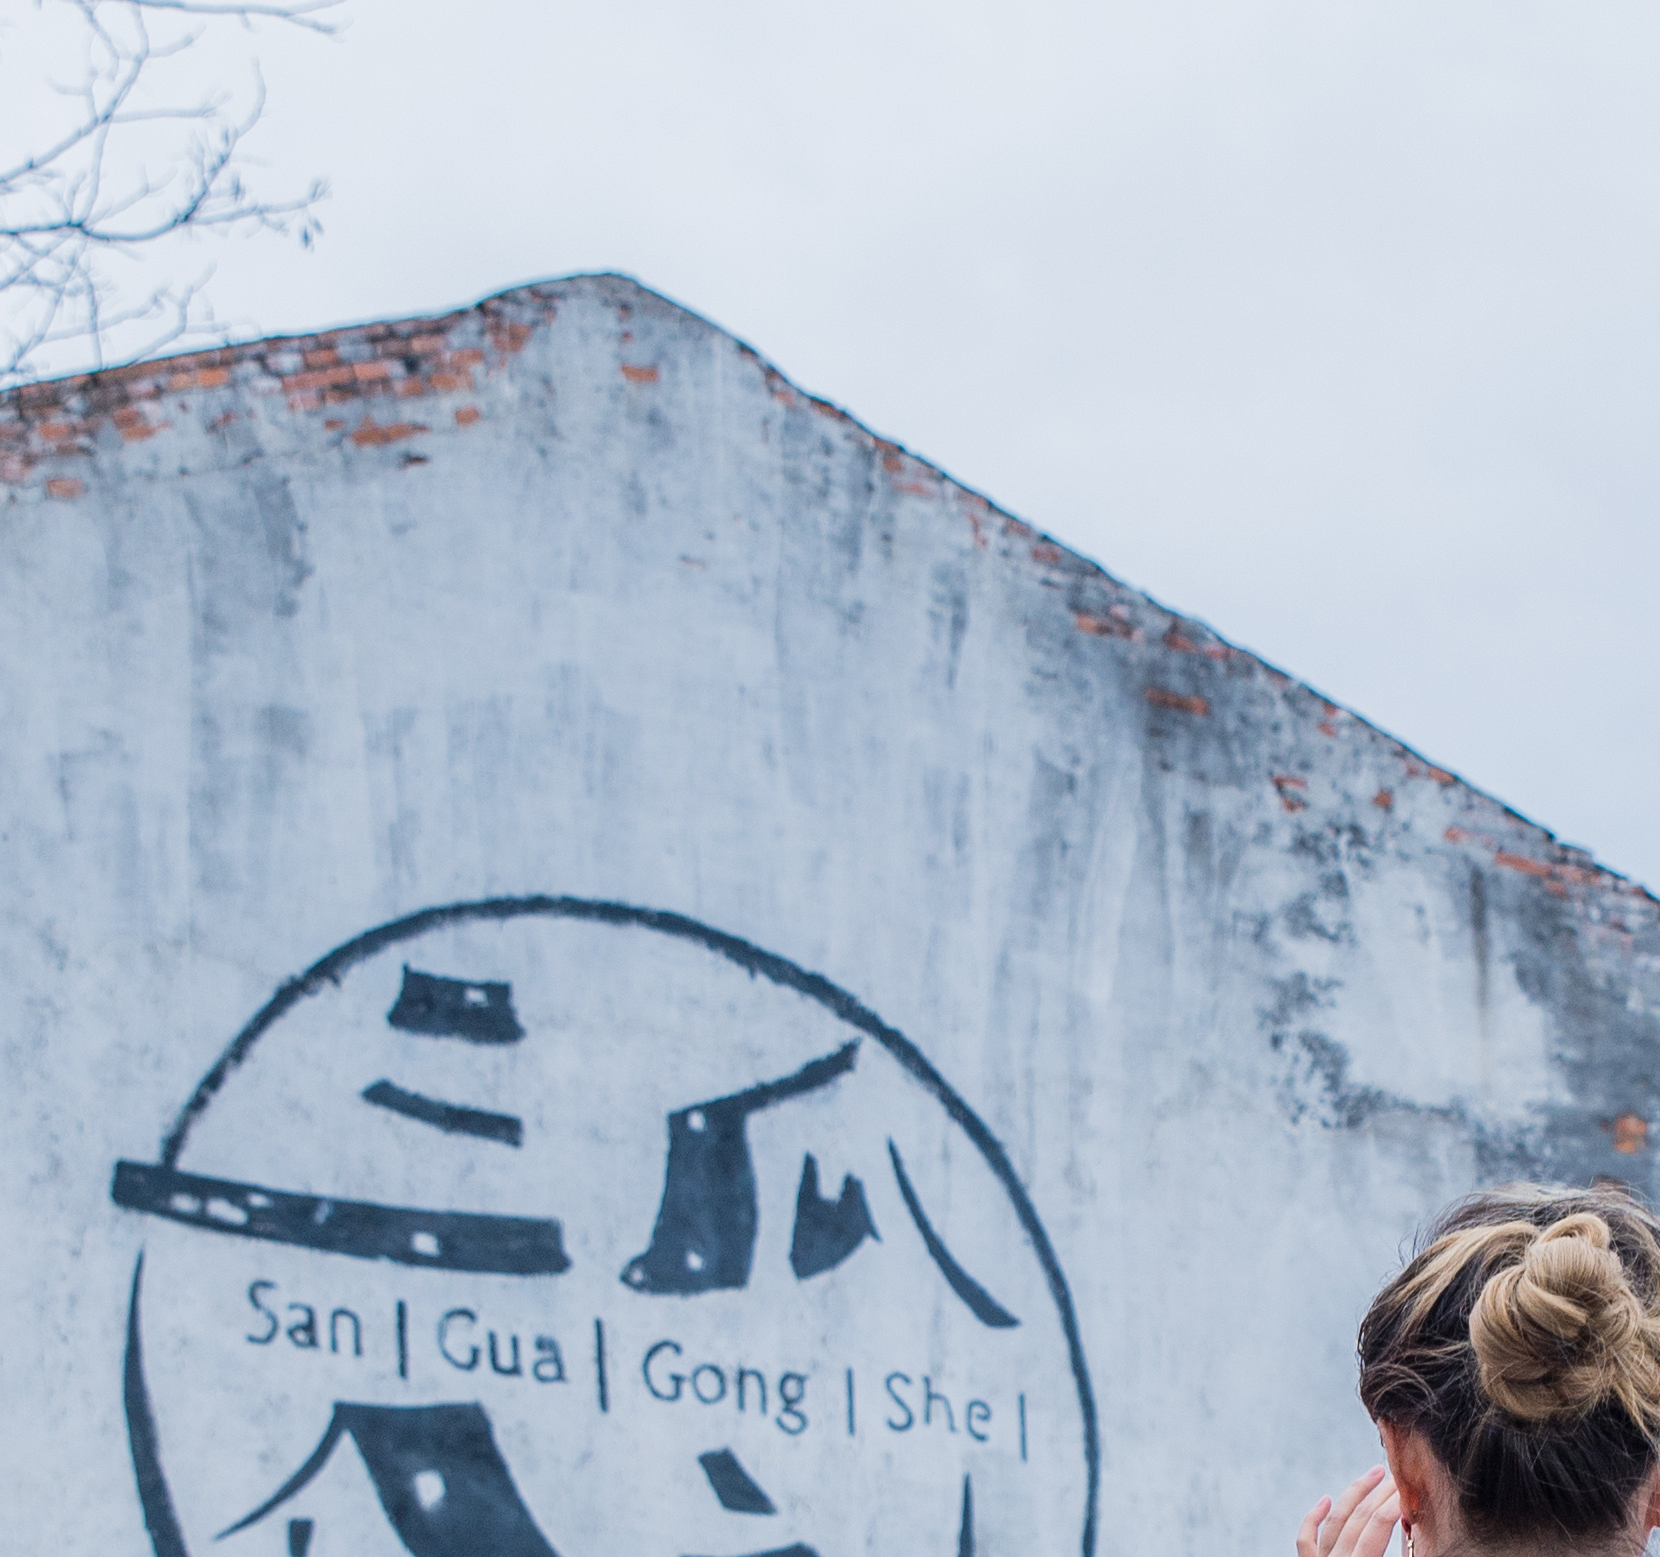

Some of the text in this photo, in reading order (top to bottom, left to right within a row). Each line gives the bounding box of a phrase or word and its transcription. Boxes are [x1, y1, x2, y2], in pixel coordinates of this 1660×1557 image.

[246, 1279, 992, 1443] San Gua Gong She
